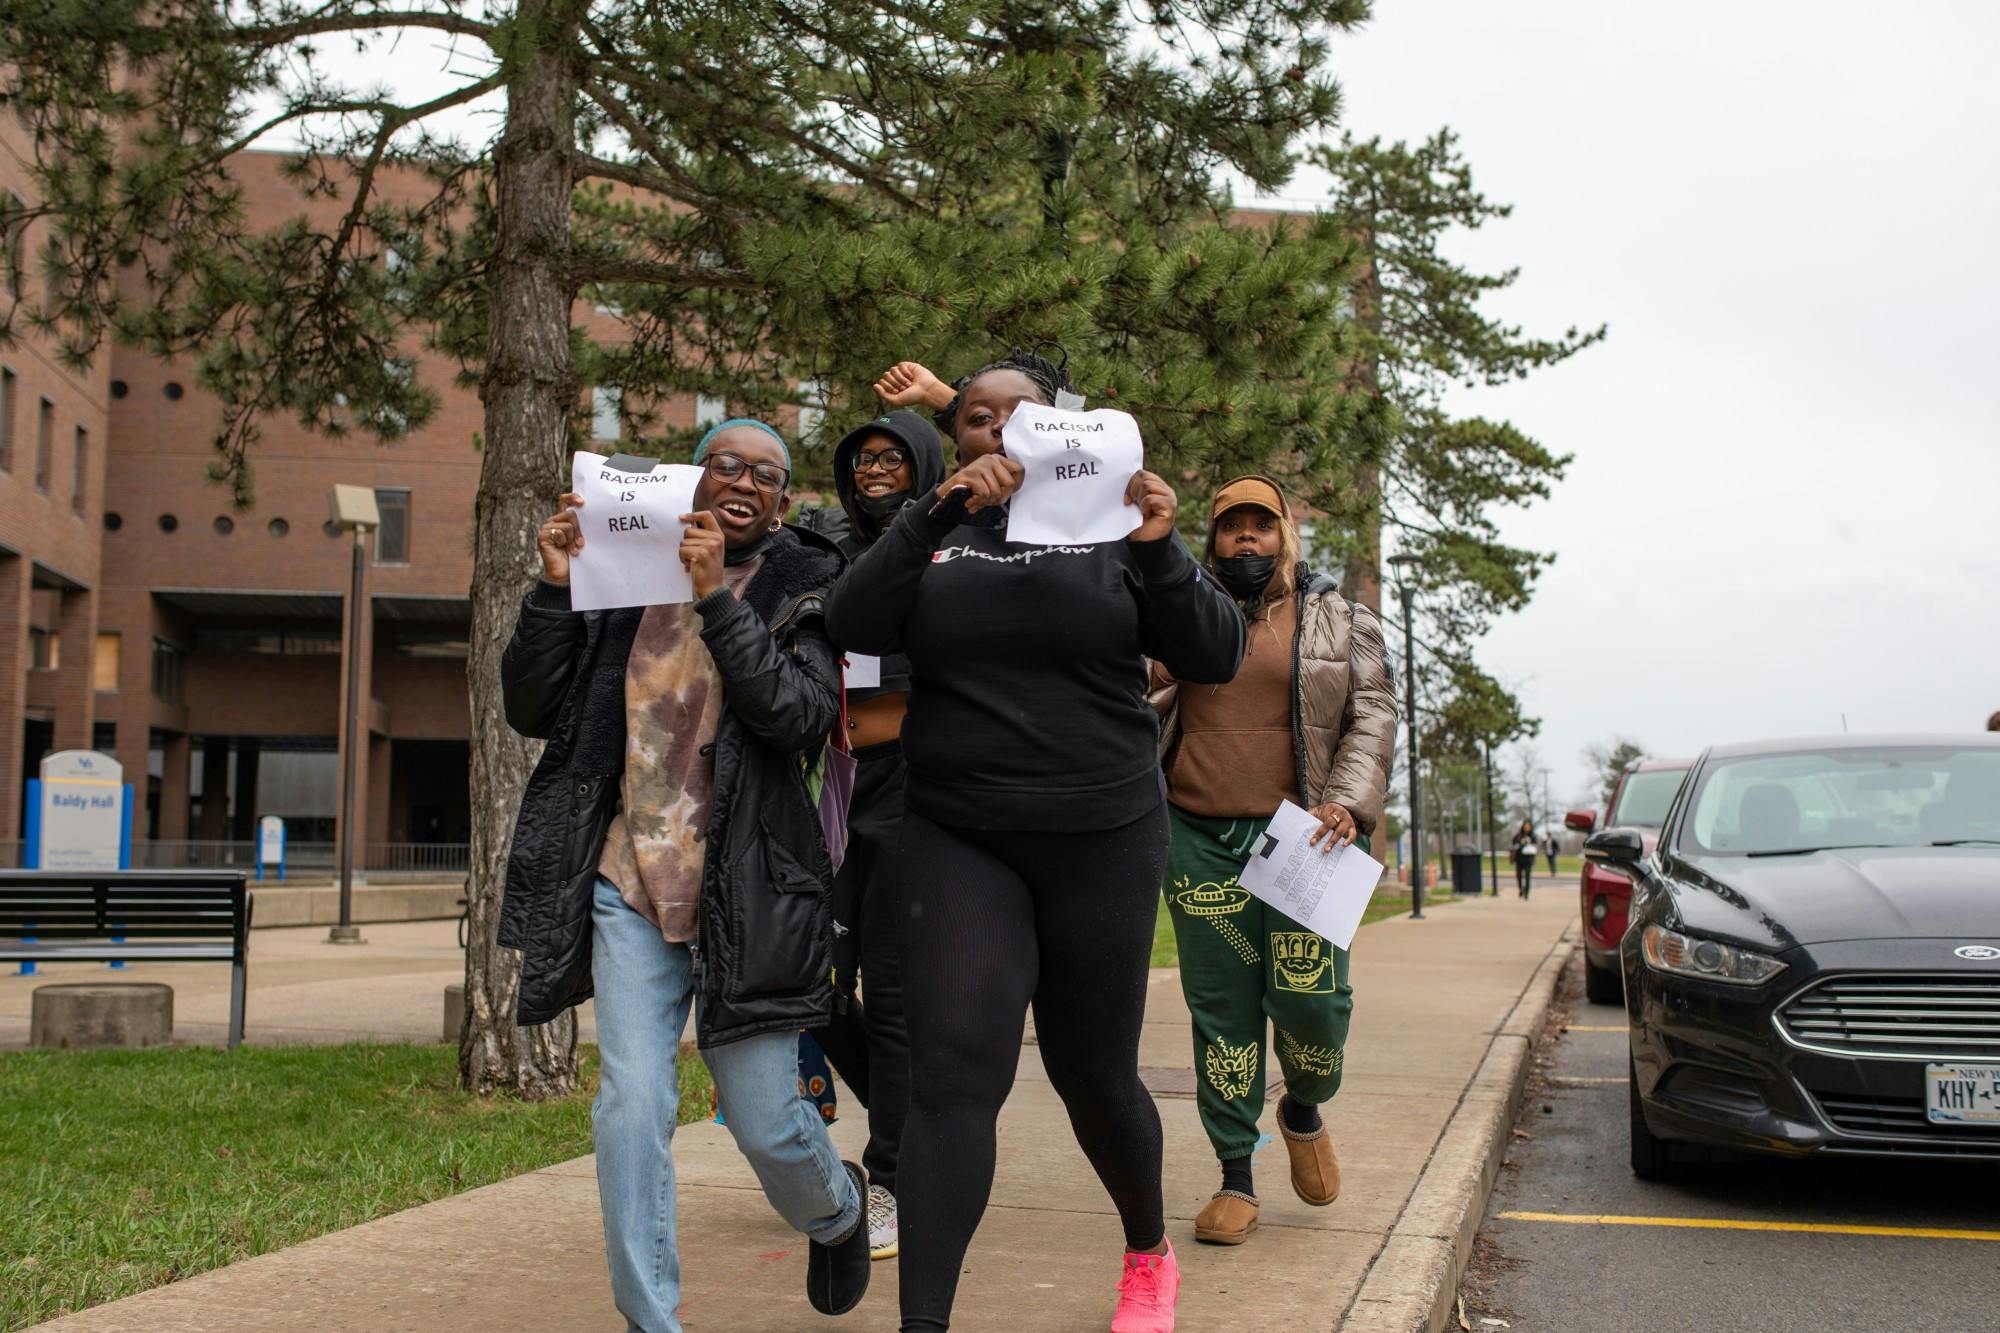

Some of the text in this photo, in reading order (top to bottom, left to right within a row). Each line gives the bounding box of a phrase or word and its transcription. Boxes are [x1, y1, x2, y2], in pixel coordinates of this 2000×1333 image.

[1034, 422, 1104, 432] RACISM
[1065, 438, 1081, 449] IS
[1055, 461, 1099, 480] REAL
[600, 471, 667, 484] RACISM
[620, 490, 635, 502] IS
[608, 515, 649, 532] REAL
[931, 545, 1095, 565] Champion
[53, 794, 114, 810] Baldy Hall
[1958, 1069, 1985, 1079] NEW
